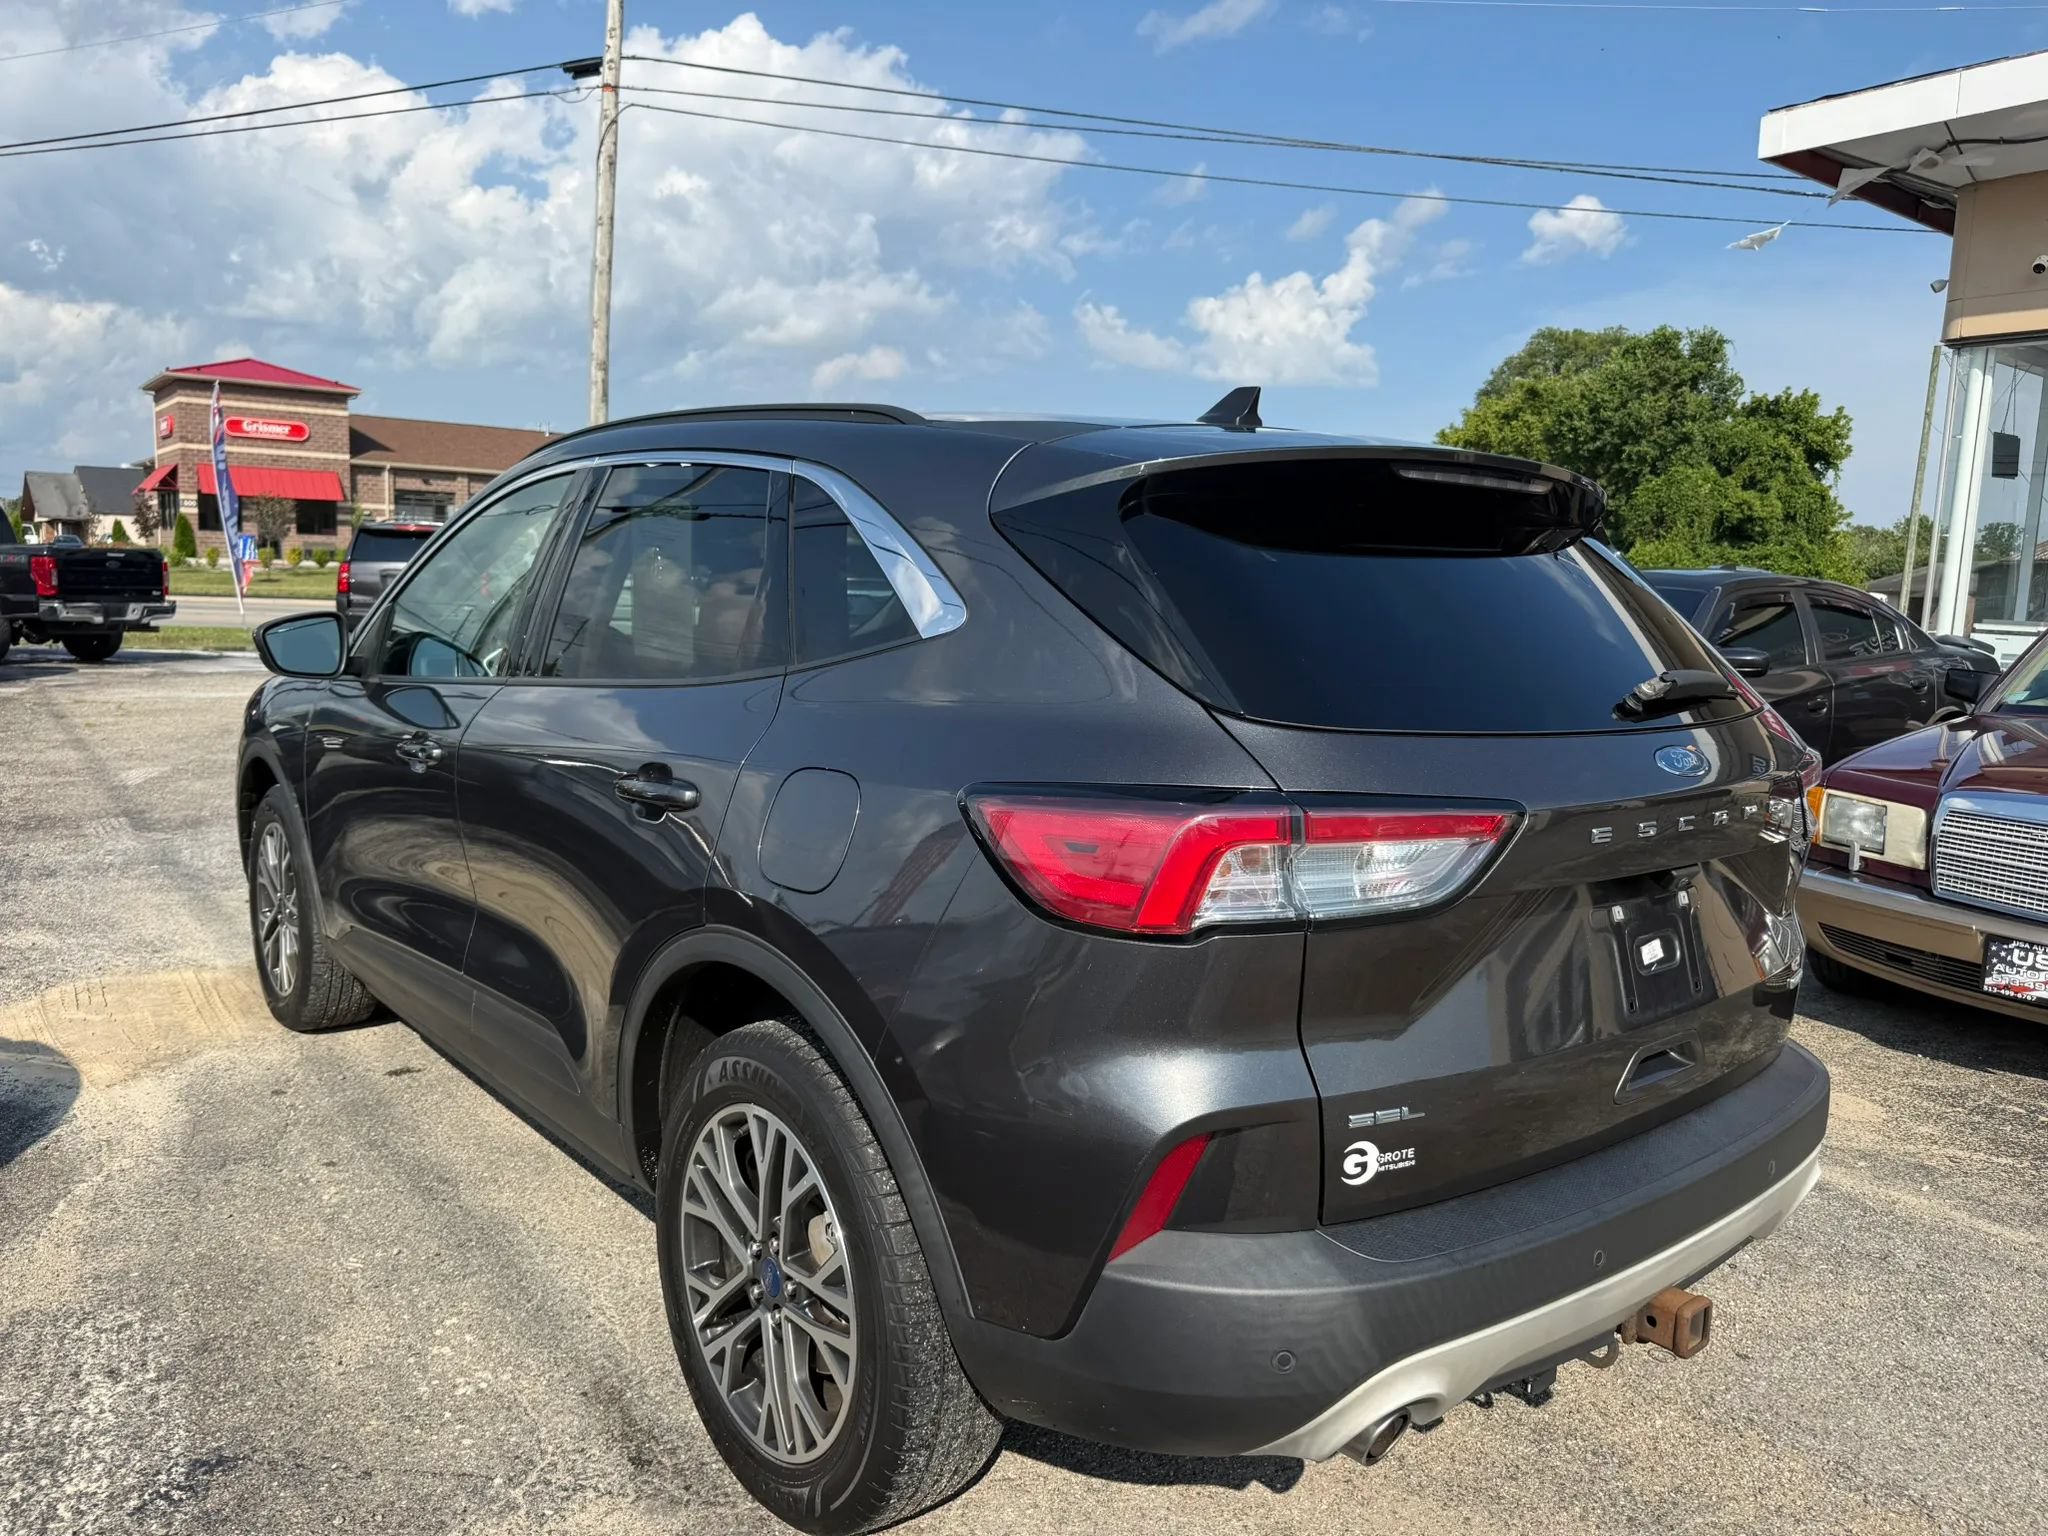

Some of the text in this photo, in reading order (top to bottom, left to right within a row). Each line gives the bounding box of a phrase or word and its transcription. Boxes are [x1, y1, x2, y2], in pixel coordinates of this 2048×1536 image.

[242, 419, 291, 434] Grismer
[1348, 1106, 1426, 1129] SEL
[1377, 1147, 1415, 1164] GROTE
[1377, 1159, 1416, 1172] MITSUBISHI
